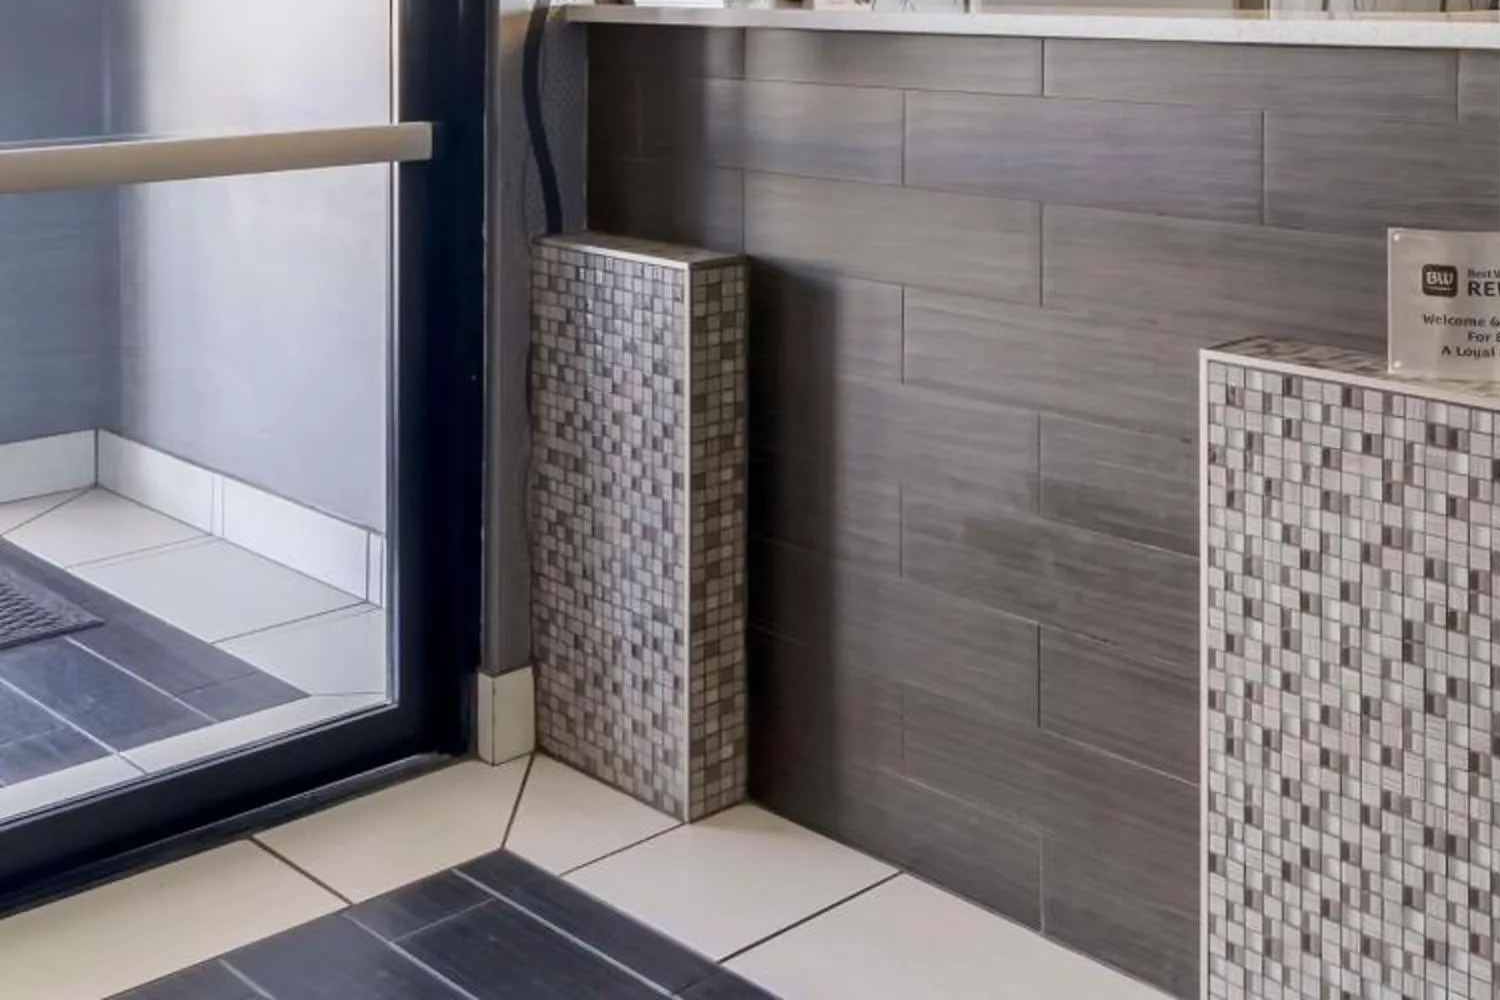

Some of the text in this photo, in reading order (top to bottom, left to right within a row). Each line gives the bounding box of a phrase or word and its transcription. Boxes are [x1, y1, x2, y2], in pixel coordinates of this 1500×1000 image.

[1426, 271, 1454, 286] BW
[1467, 269, 1491, 278] Best
[1423, 313, 1485, 328] Welcome
[1489, 316, 1500, 327] &
[1467, 331, 1490, 343] For
[1441, 346, 1451, 356] A
[1456, 346, 1496, 359] Loyal
